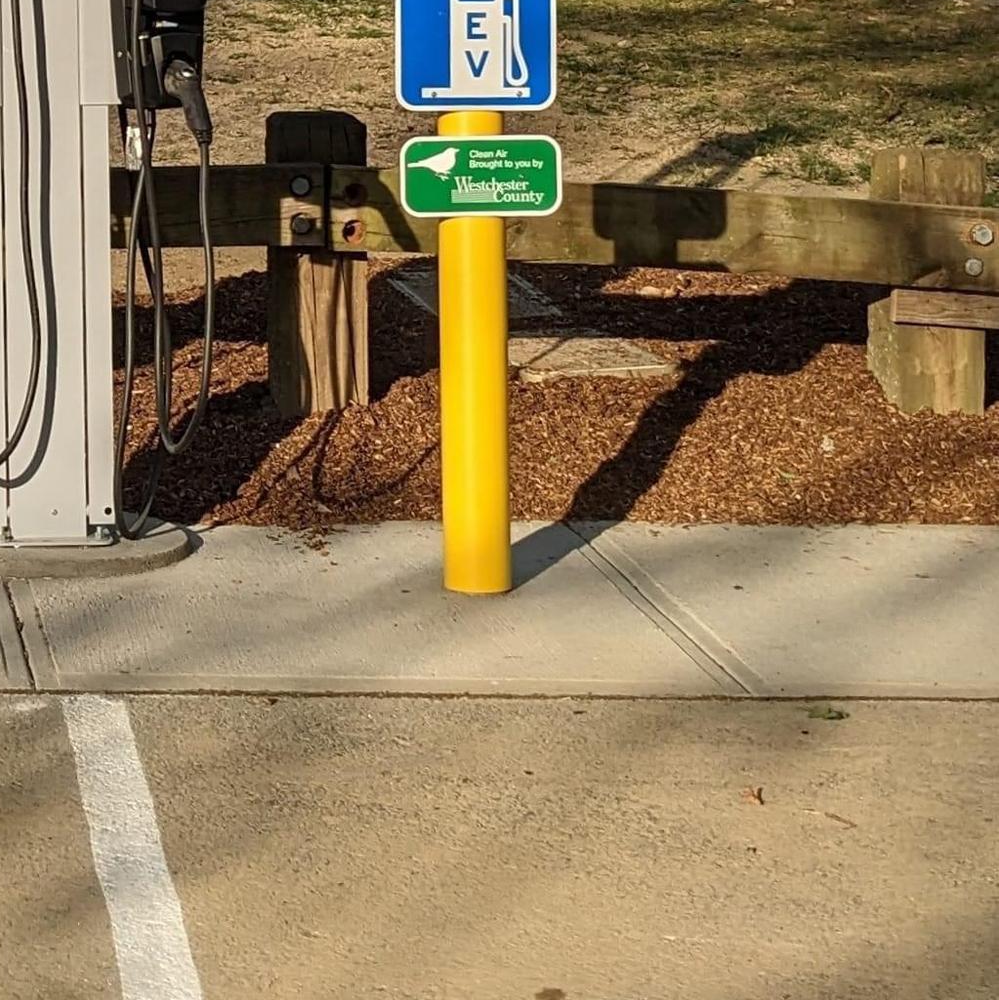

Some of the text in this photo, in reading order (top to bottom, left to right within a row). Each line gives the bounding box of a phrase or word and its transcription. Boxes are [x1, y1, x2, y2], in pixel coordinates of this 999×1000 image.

[469, 149, 508, 158] Clean Air
[469, 158, 543, 170] Brought to you by
[454, 175, 529, 193] Westchester
[493, 190, 544, 205] County
